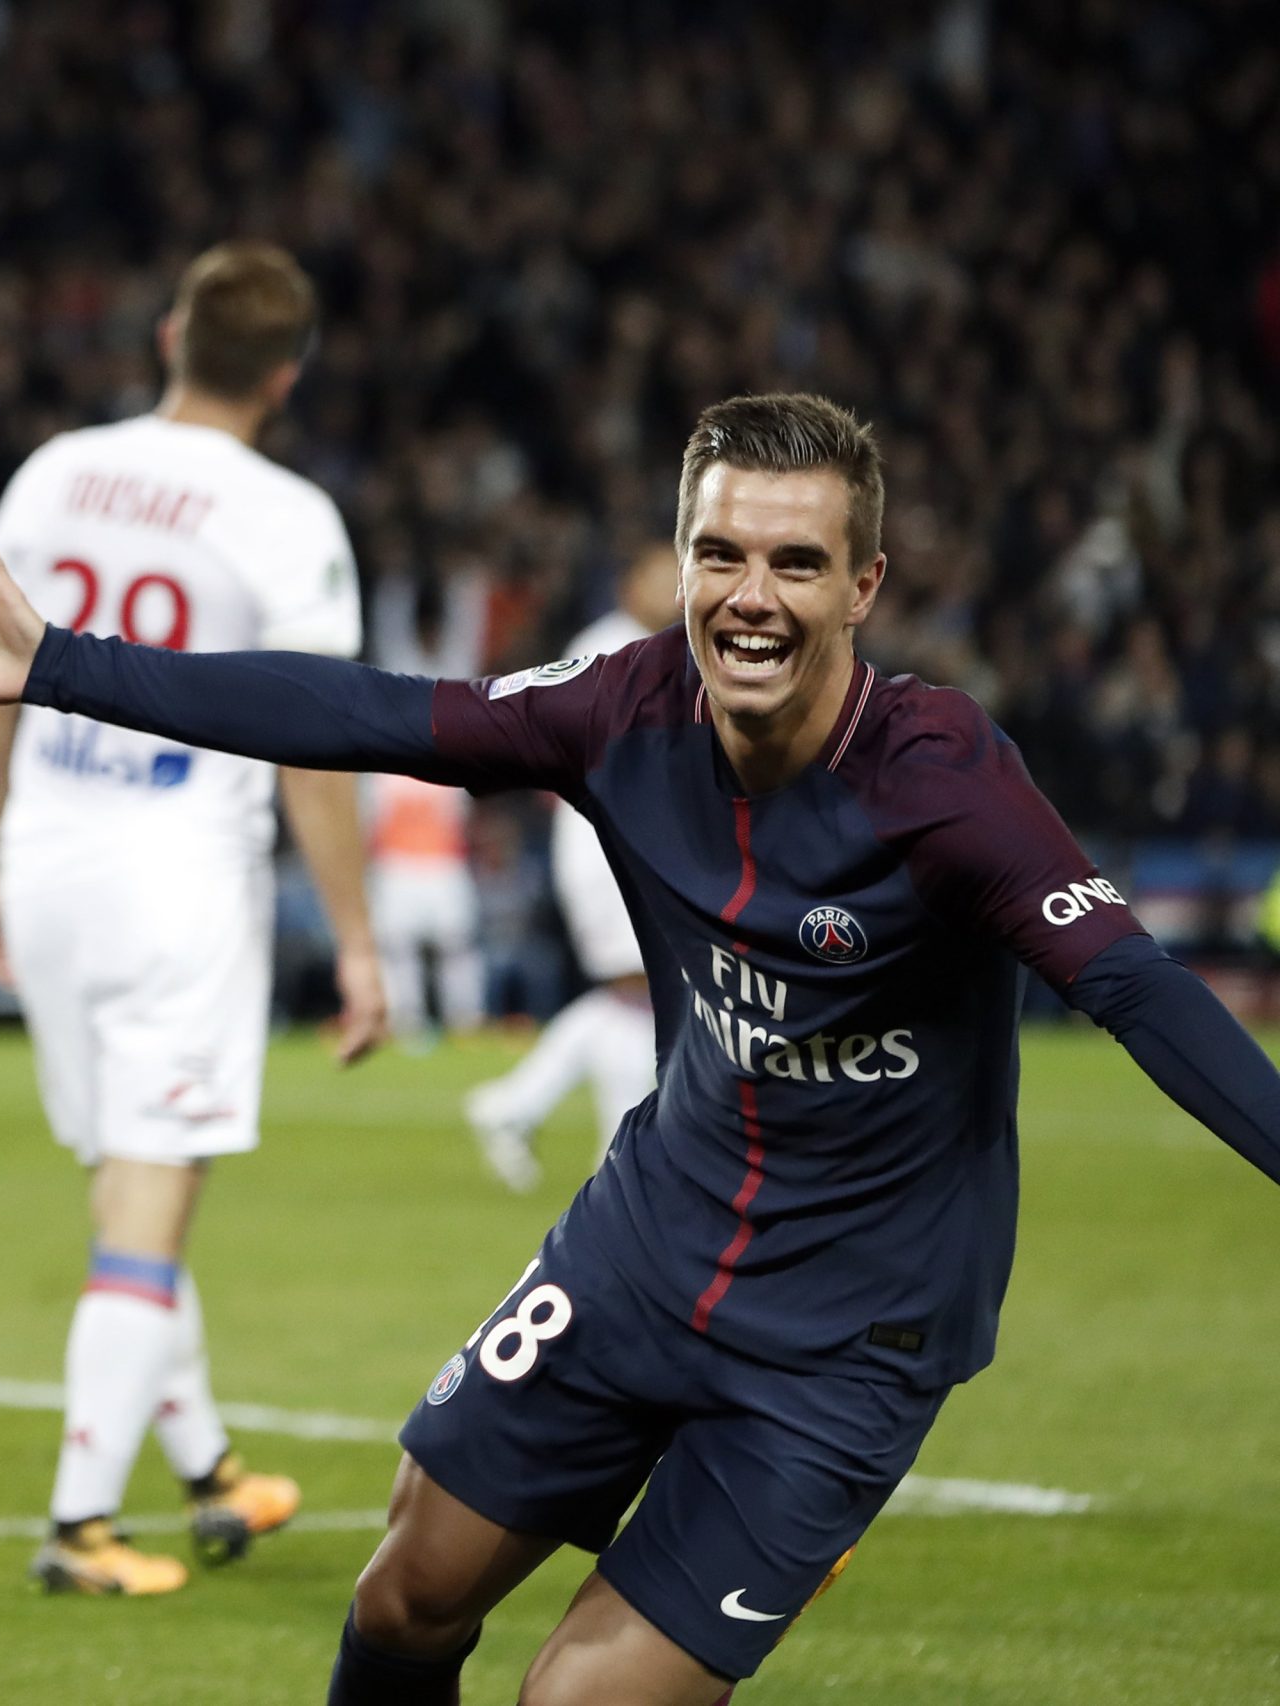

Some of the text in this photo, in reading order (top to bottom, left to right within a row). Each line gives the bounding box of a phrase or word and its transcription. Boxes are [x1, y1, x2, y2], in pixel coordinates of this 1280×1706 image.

[806, 909, 850, 927] PARIS
[1042, 877, 1128, 926] QNB
[711, 943, 787, 1022] Fly
[682, 966, 920, 1083] mirates
